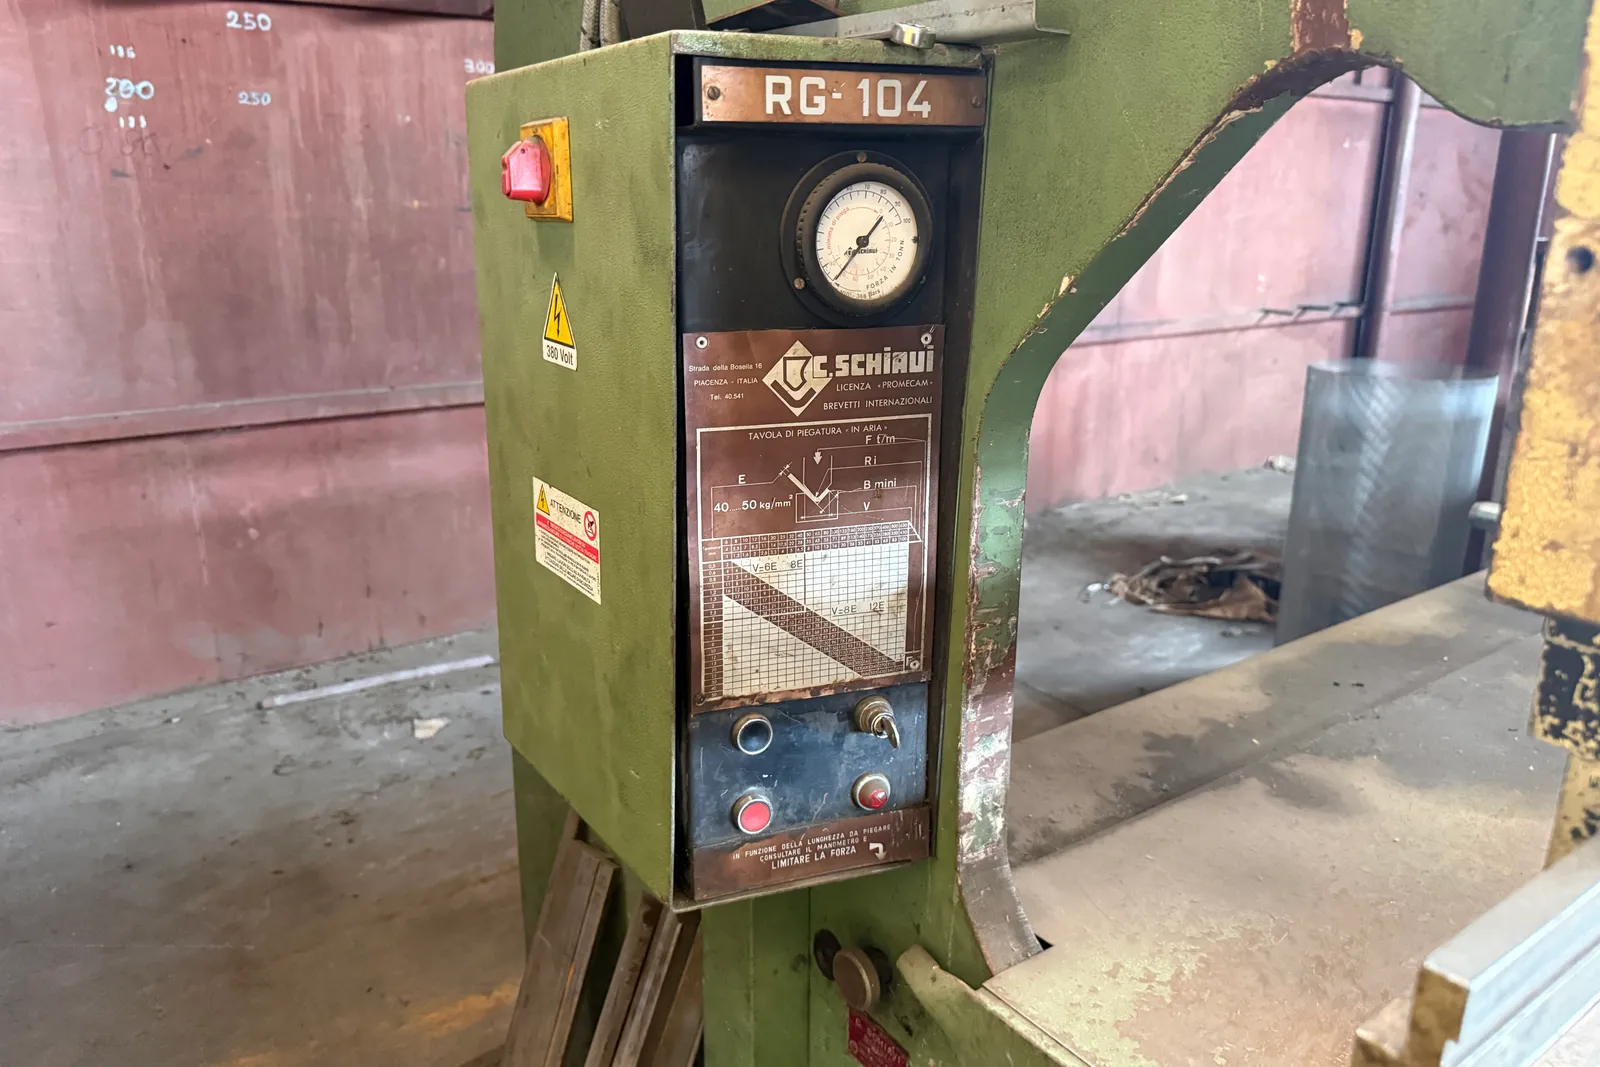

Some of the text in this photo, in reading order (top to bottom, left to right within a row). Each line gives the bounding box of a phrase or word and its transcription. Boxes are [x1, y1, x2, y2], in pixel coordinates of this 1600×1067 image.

[226, 10, 271, 31] 250
[238, 91, 272, 106] 250
[857, 78, 931, 119] 104
[866, 275, 888, 290] FORZA
[889, 265, 897, 274] IN
[546, 344, 574, 366] 380 Volt
[688, 364, 710, 372] Strada
[693, 378, 728, 386] PIACENZA
[736, 377, 758, 385] ITALIA
[836, 382, 872, 392] LICENZA
[710, 393, 721, 401] Tel.
[823, 396, 933, 411] BREVETTI INTERNAZIONALI
[748, 431, 782, 441] TAVOLA
[785, 429, 794, 438] DI
[797, 427, 842, 437] PIEGATURA
[865, 434, 872, 445] F
[738, 474, 746, 484] E
[863, 478, 897, 489] B mini
[550, 499, 581, 524] ATTENZIONE
[863, 501, 871, 511] V
[752, 560, 803, 572] V=6E 8E
[831, 600, 885, 615] V=8E 12E
[732, 824, 891, 860] IN FUNZIONE DELLA LUNGHEZZA DA PIEGARE
[759, 847, 801, 862] CONSULTARE
[805, 845, 812, 853] IL
[817, 837, 859, 850] MANOMETRO
[771, 845, 857, 870] LIMITARE LA FORZA
